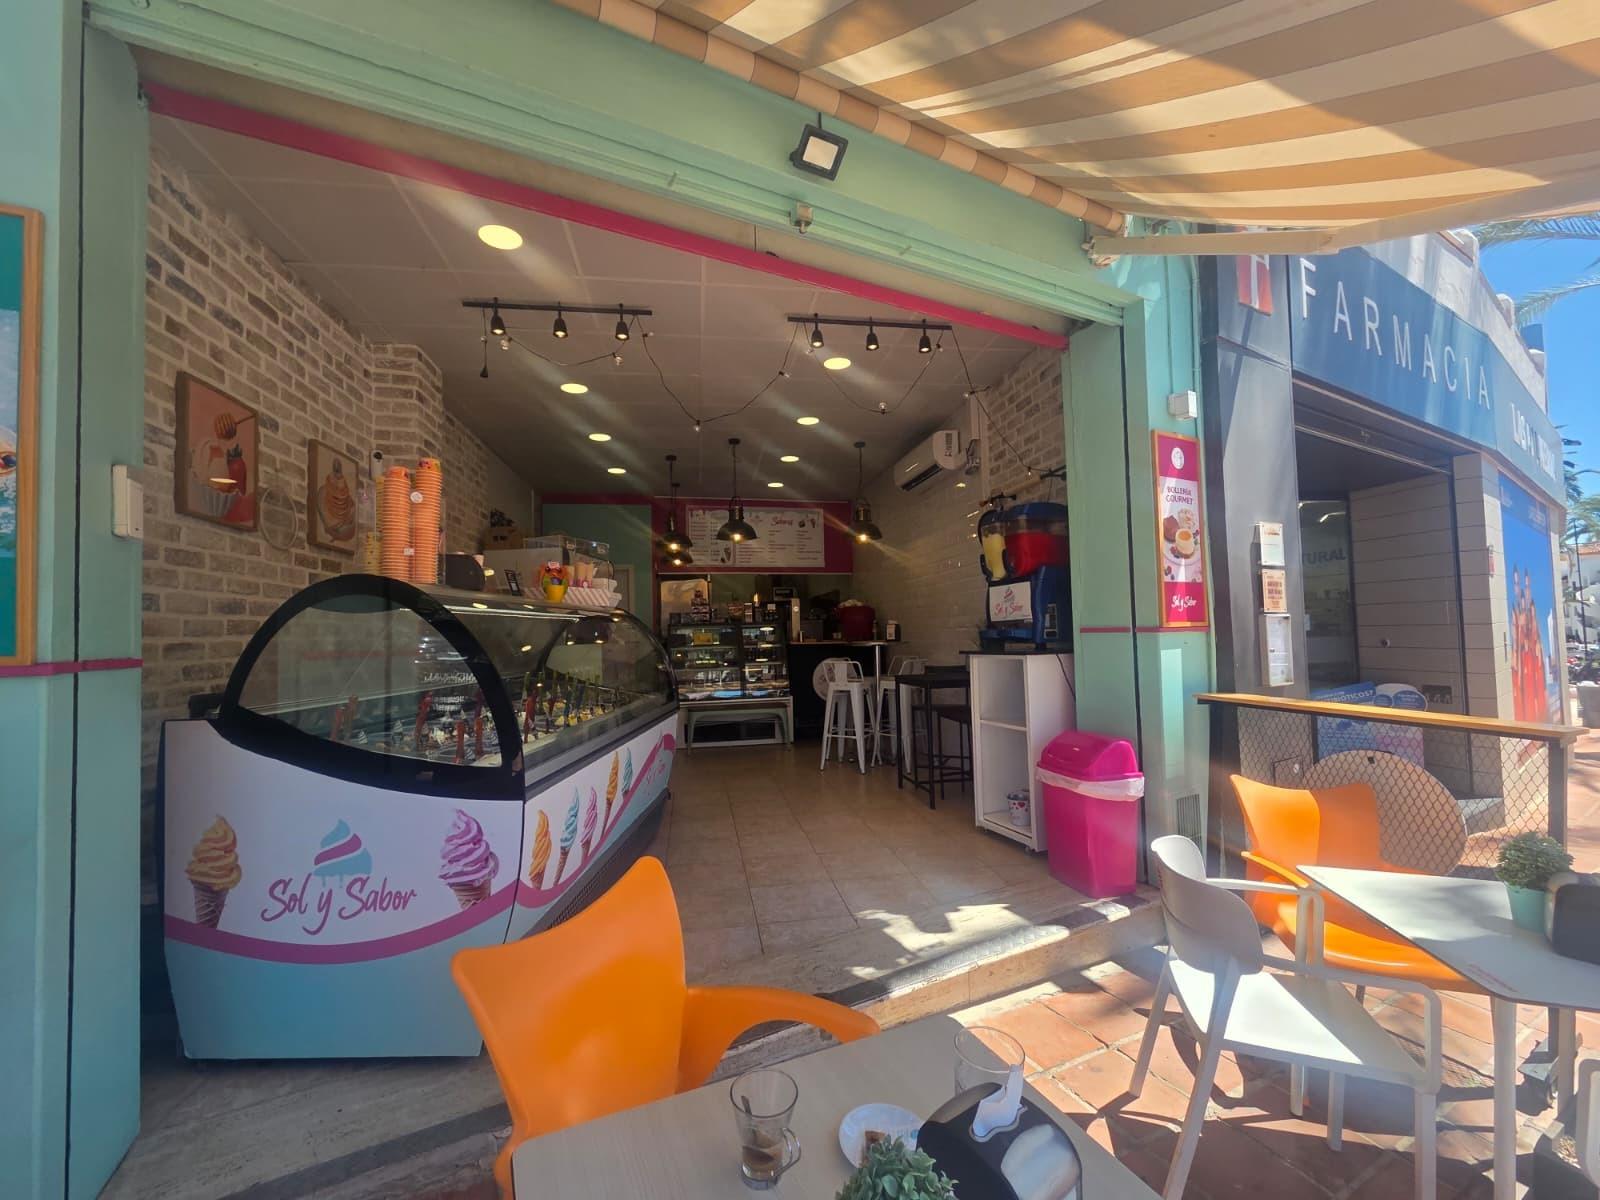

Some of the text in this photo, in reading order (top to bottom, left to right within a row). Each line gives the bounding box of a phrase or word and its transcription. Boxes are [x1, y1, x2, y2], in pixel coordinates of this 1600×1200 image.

[1299, 257, 1491, 411] FARMACIA
[260, 872, 417, 936] Sol y Sabor
